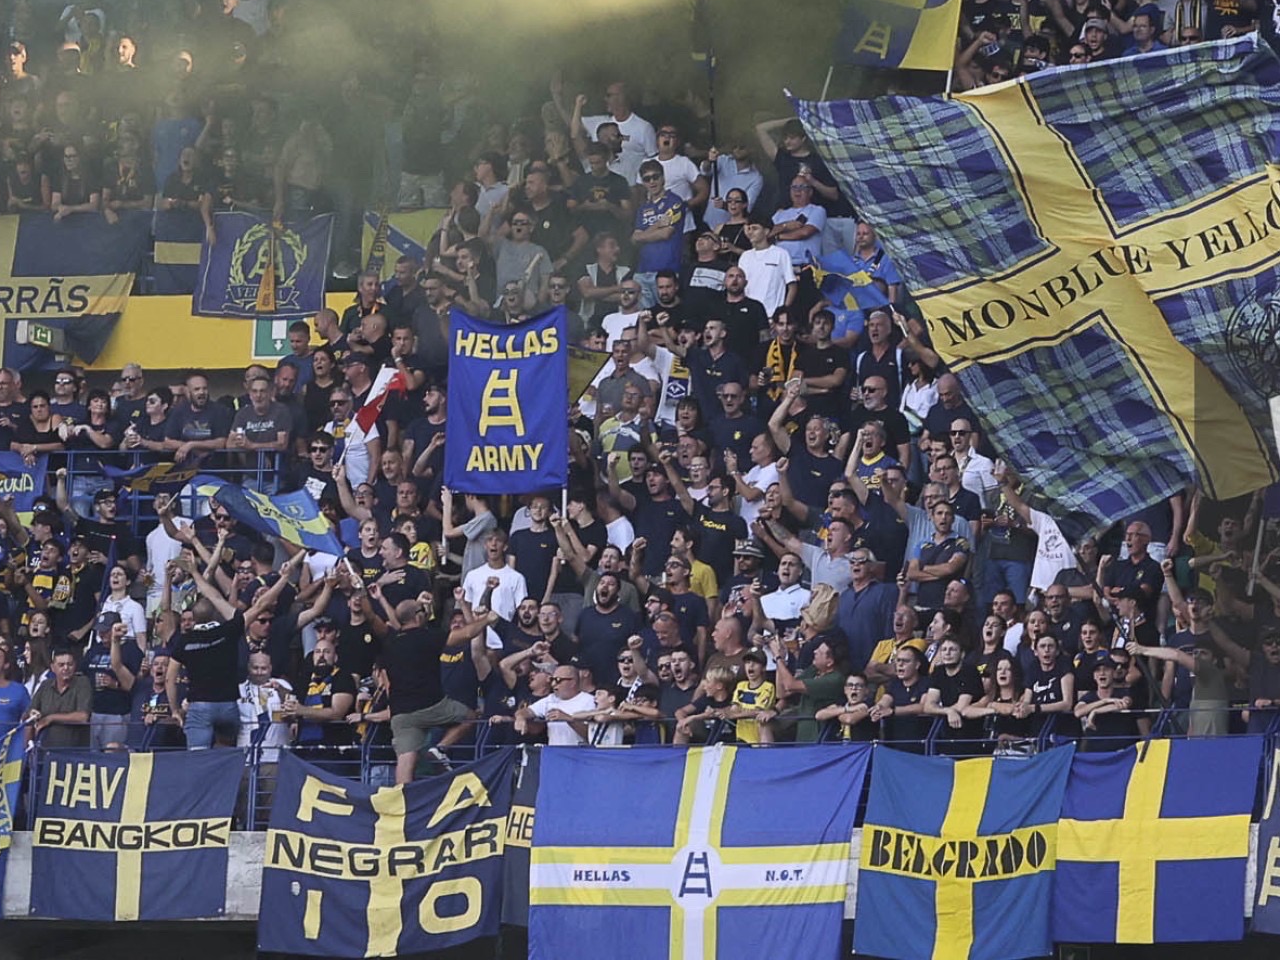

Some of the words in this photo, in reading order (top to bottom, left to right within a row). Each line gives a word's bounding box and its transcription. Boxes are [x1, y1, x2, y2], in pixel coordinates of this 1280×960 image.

[455, 327, 559, 360] HELLAS
[466, 443, 544, 472] ARMY
[38, 819, 229, 850] BANGKOK
[506, 811, 535, 841] HE
[271, 822, 498, 878] NEGRAR
[869, 829, 1048, 878] BELGRADO
[573, 869, 632, 883] HELLAS
[765, 868, 804, 882] N.O.T.
